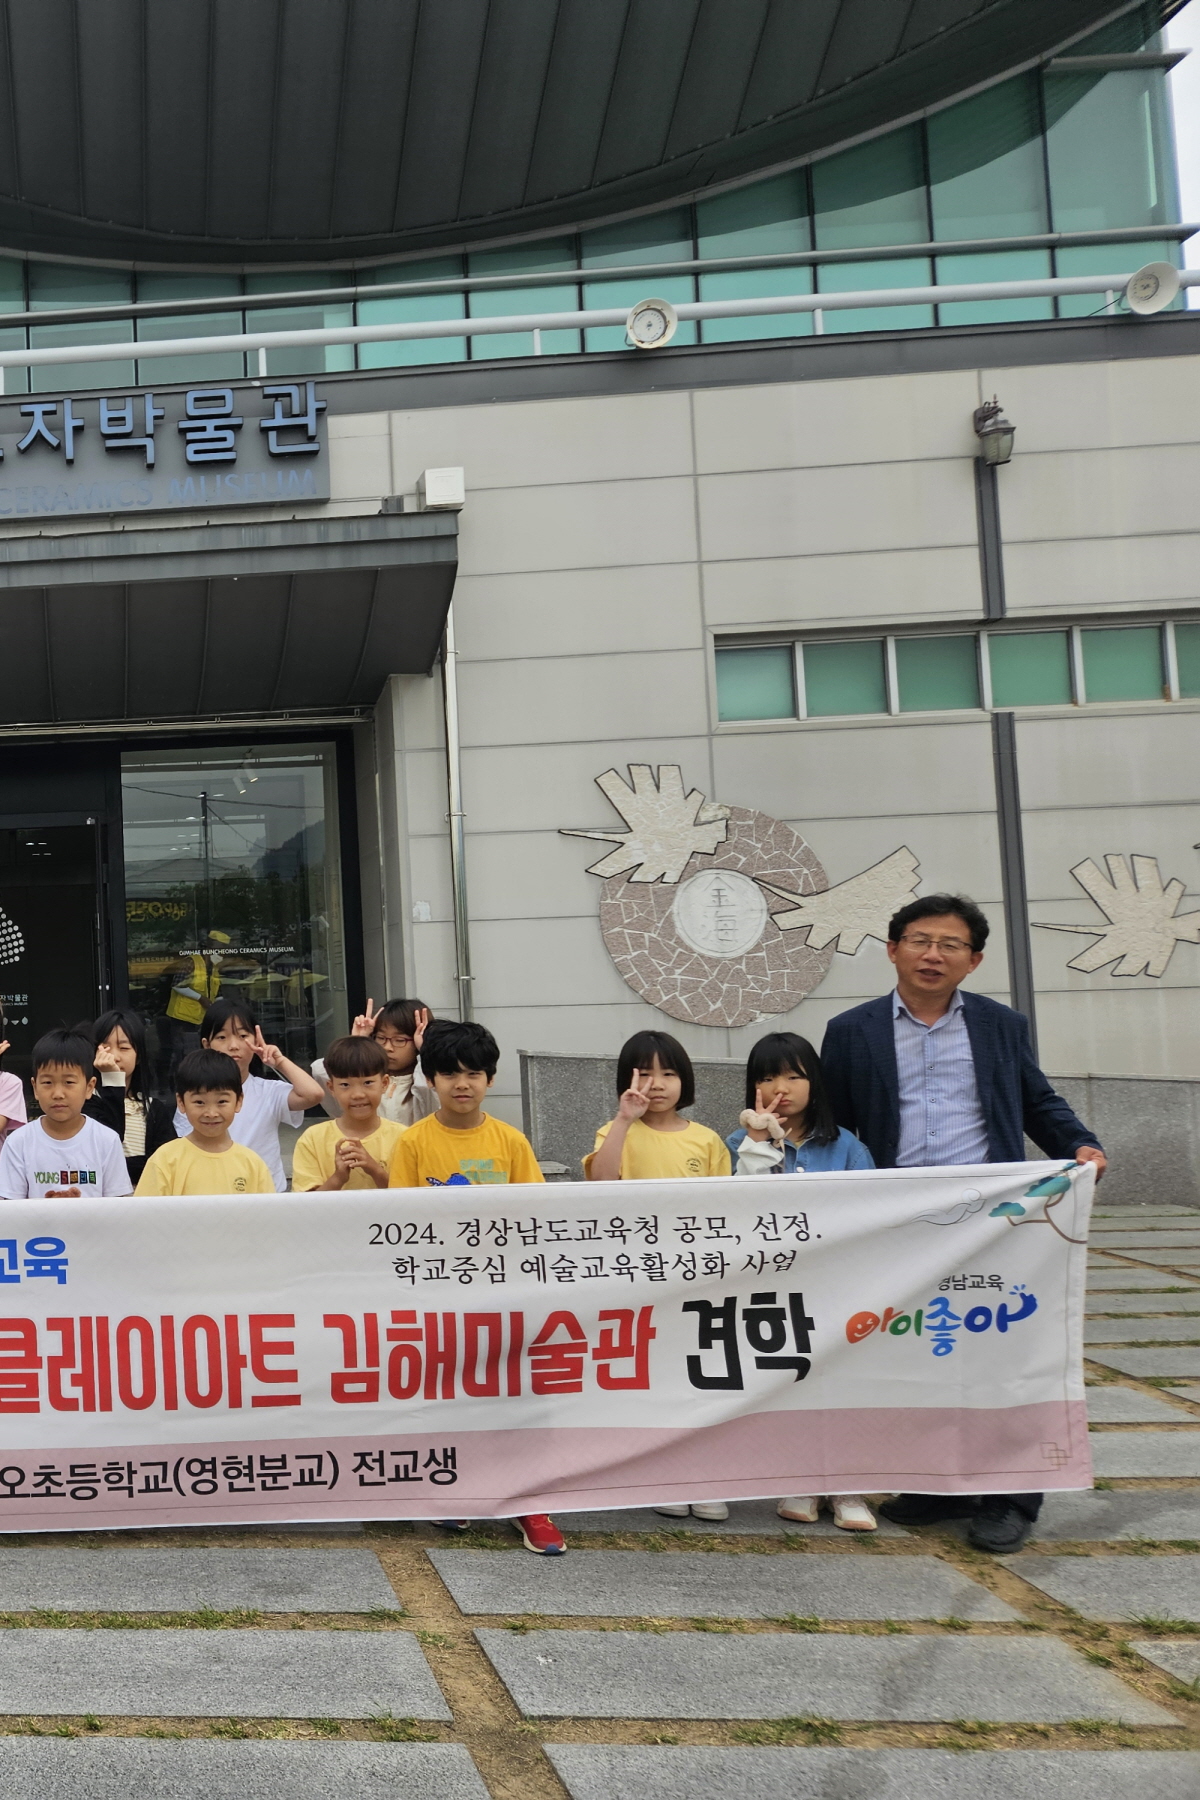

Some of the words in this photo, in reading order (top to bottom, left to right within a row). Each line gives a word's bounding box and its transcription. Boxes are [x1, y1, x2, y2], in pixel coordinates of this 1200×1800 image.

[168, 468, 318, 505] MUSEUM
[33, 1171, 59, 1184] YOUNG
[368, 1222, 445, 1246] 2024.
[456, 1214, 660, 1247] 경상남도교육청
[672, 1215, 742, 1245] 공모,
[751, 1212, 822, 1243] 선정.
[392, 1254, 506, 1286] 학교중심
[520, 1251, 731, 1285] 예술교육활성화
[739, 1249, 798, 1276] 사업
[937, 1273, 1005, 1292] 경남교육
[845, 1292, 1038, 1357] 아이좋아
[323, 1305, 657, 1404] 김해미술관
[682, 1292, 815, 1391] 견학
[351, 1446, 458, 1488] 전교생
